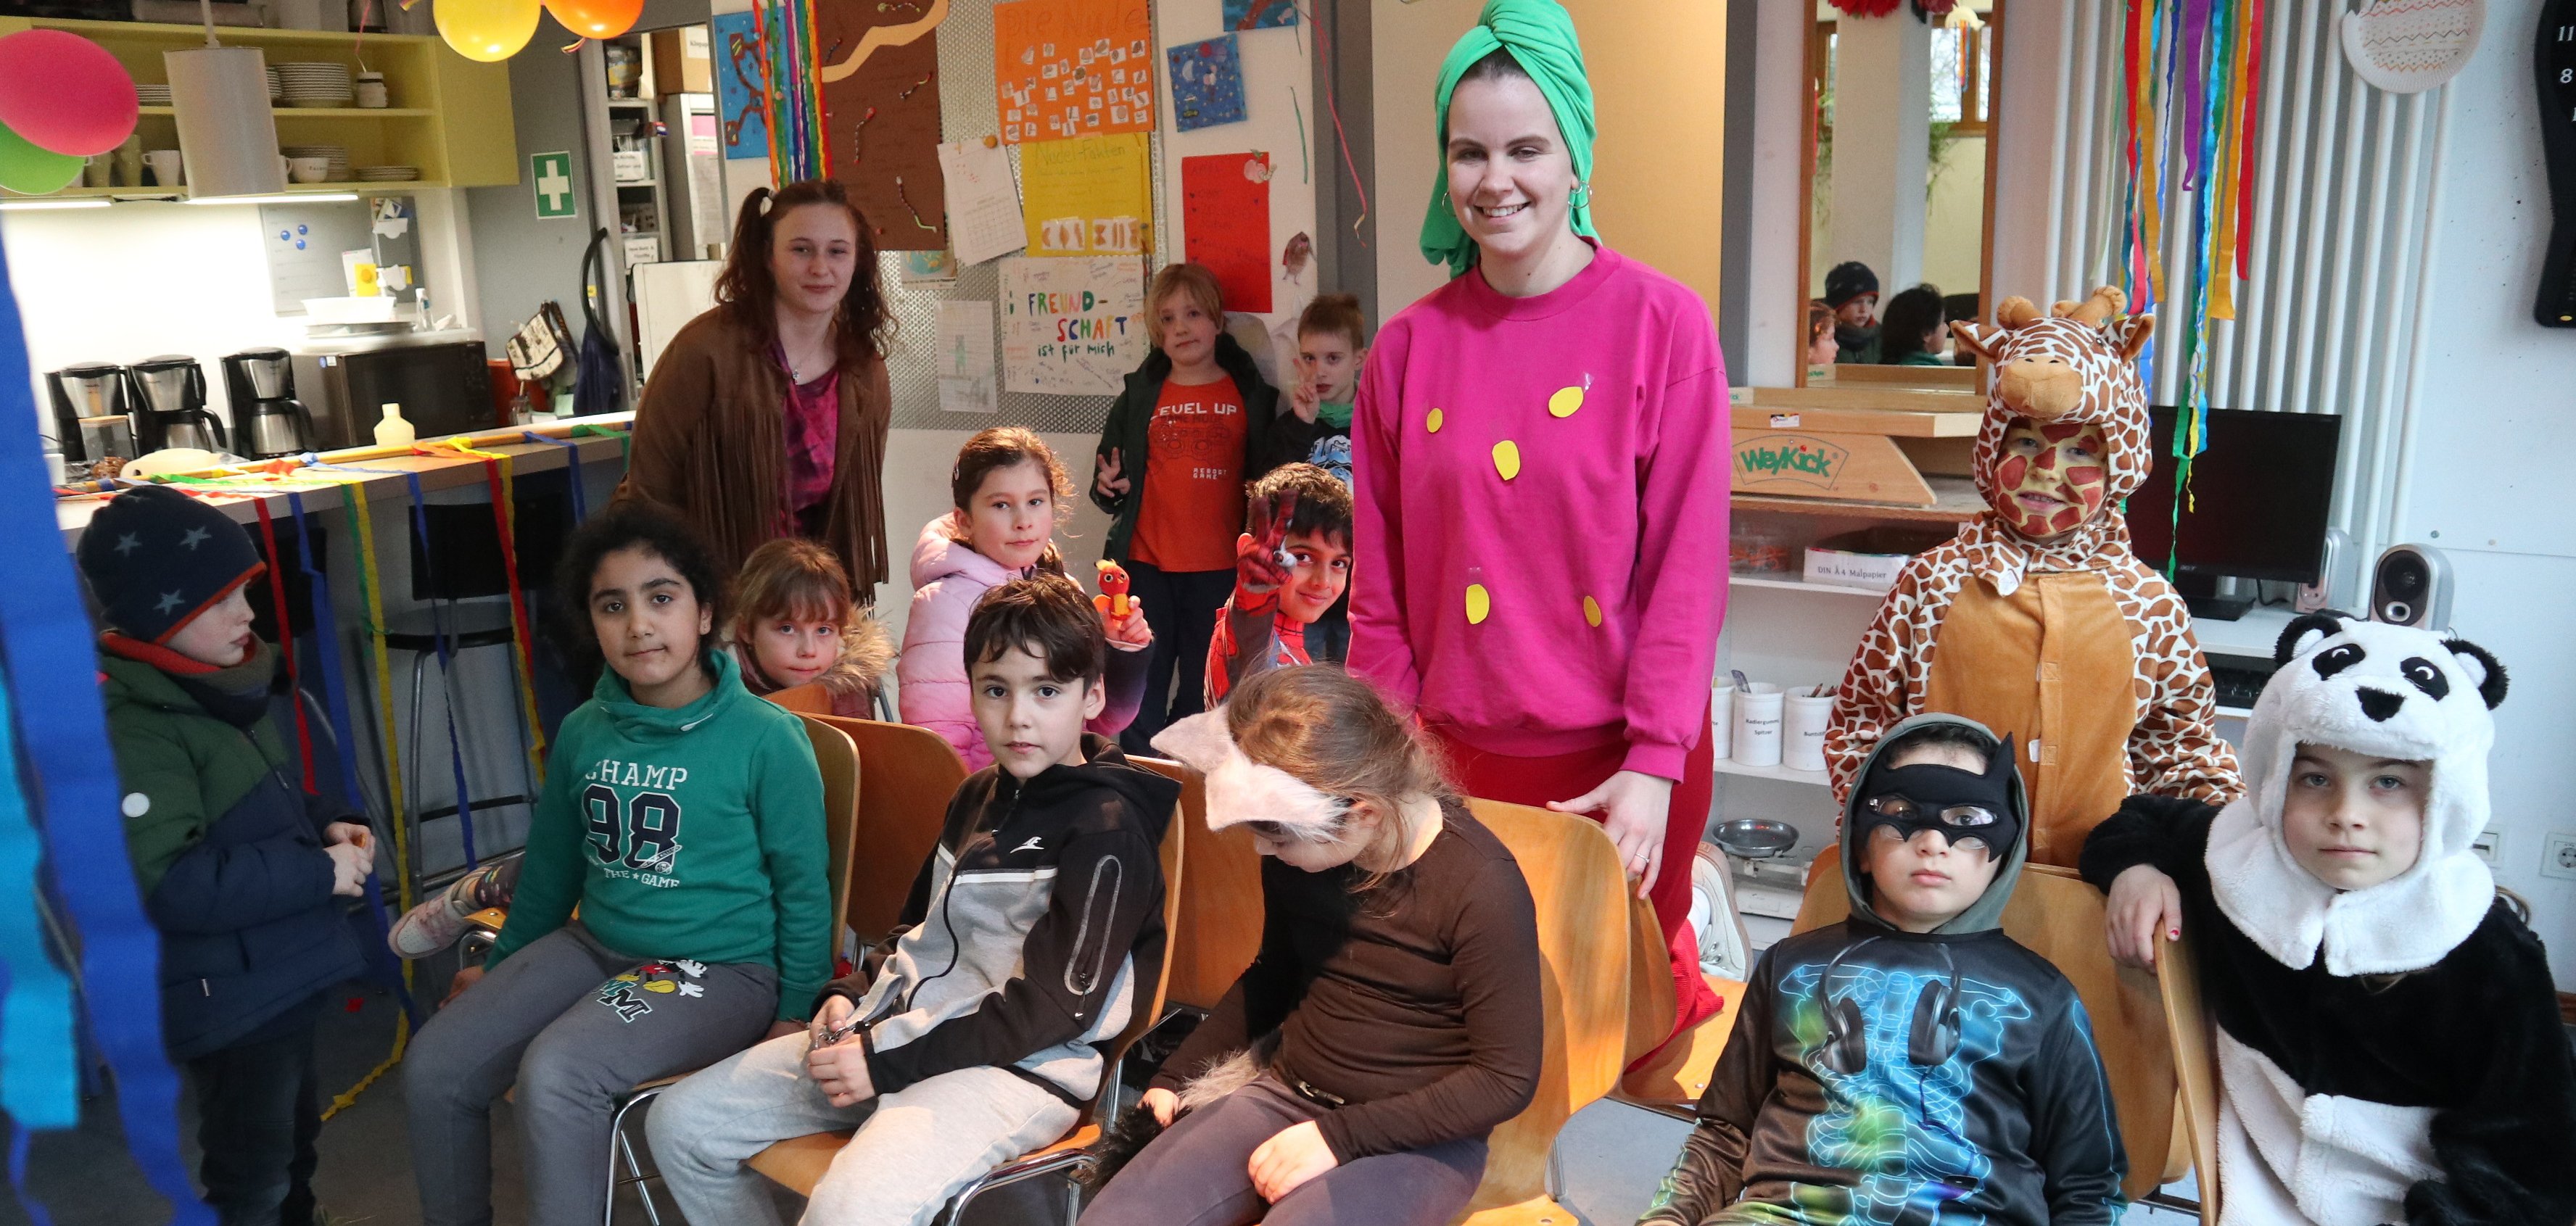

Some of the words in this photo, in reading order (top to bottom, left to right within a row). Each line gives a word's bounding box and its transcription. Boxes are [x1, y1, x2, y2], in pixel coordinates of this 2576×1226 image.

[2557, 25, 2575, 41] 11
[2559, 68, 2573, 83] 8
[1057, 315, 1127, 342] SCHAFT
[1038, 344, 1054, 357] ist
[1087, 341, 1115, 357] mich
[1158, 402, 1208, 416] EVEL
[1214, 402, 1237, 415] UP
[1740, 444, 1832, 479] WeyKick
[1849, 568, 1886, 579] Malpapier
[581, 783, 682, 871] 98
[603, 867, 630, 879] THE
